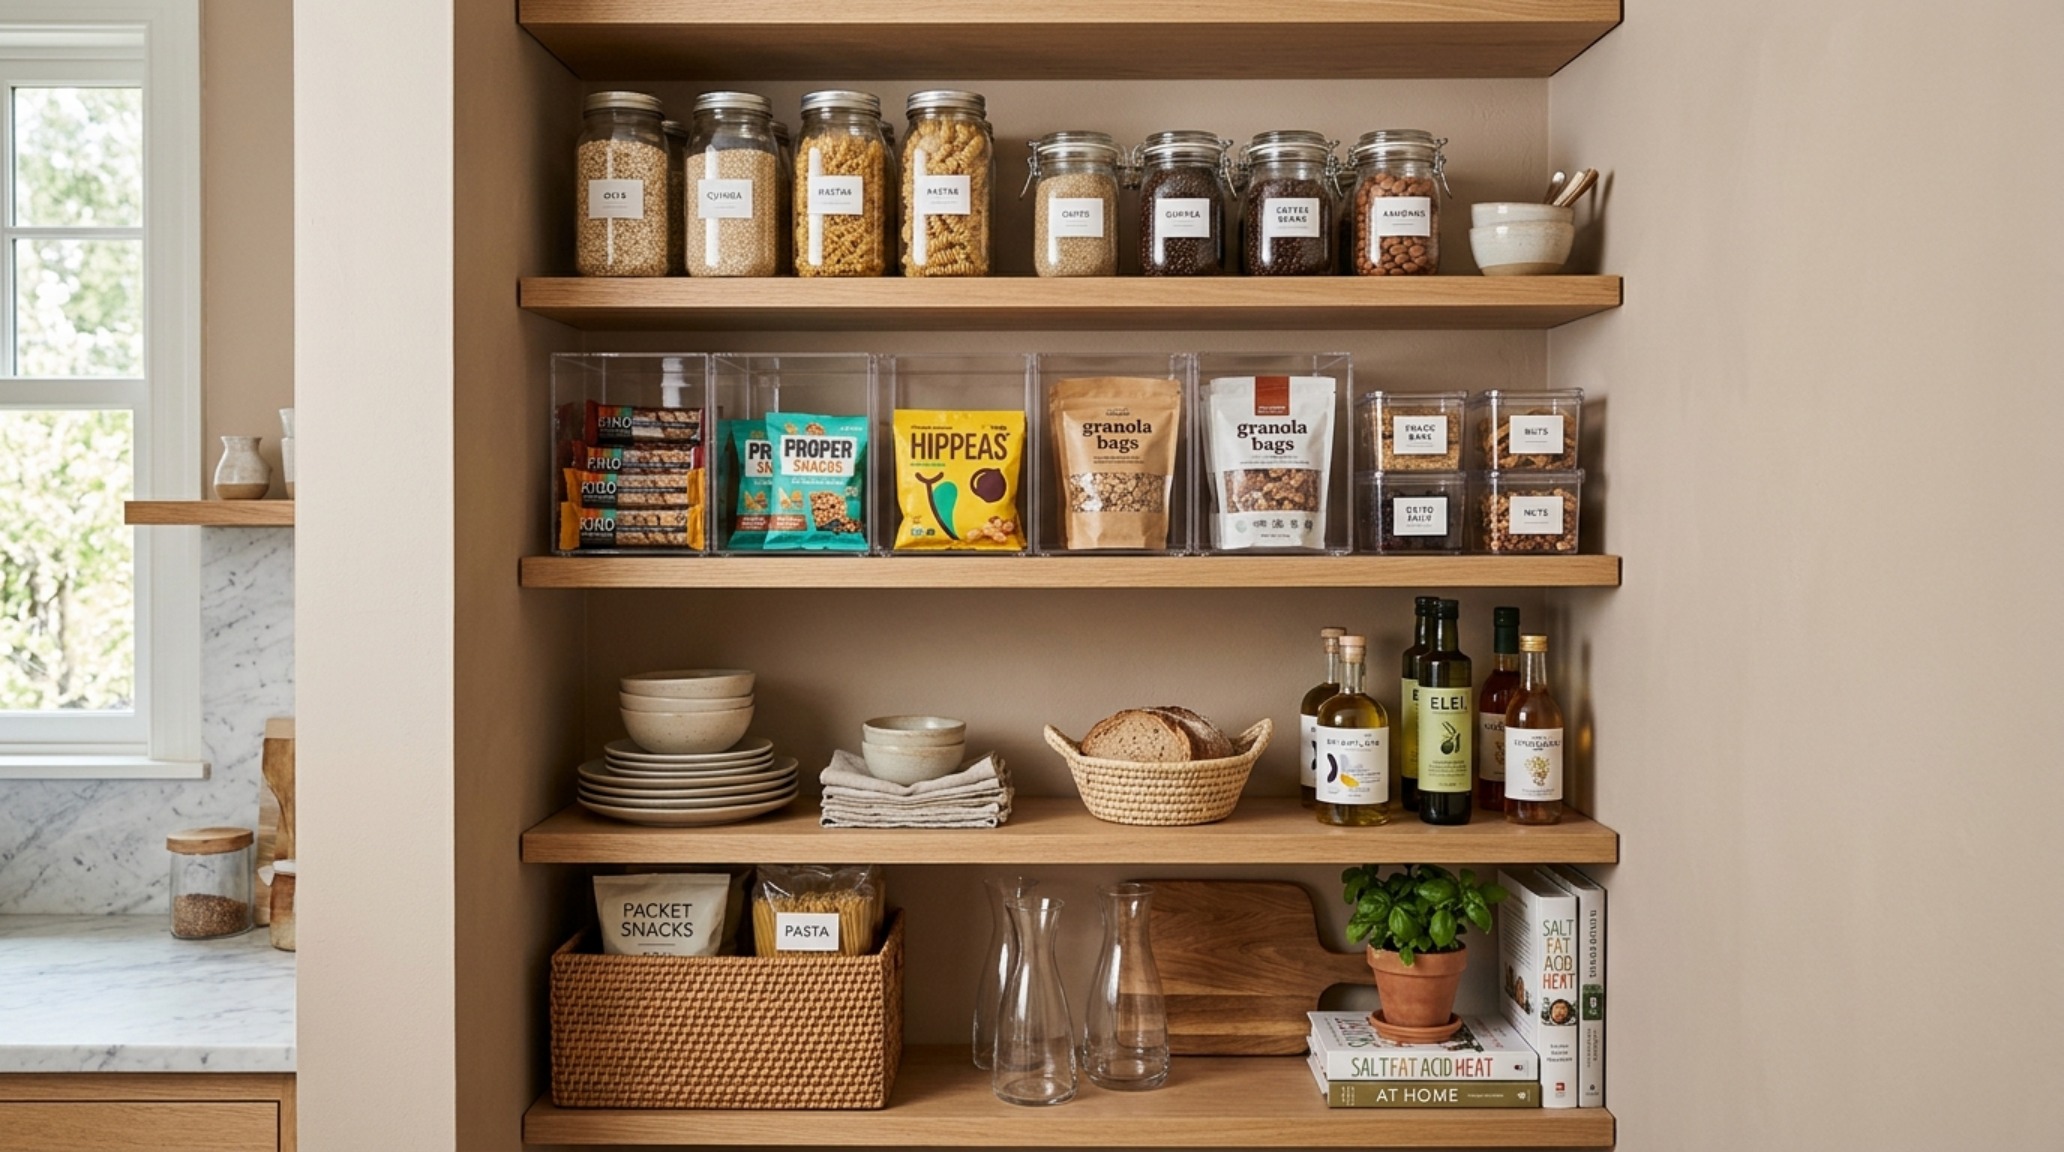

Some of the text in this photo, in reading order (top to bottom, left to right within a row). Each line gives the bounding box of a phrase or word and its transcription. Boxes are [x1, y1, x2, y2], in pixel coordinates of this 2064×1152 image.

[1082, 419, 1152, 437] granola
[1237, 419, 1308, 438] granola
[784, 438, 853, 459] PROPER
[911, 432, 1007, 460] HIPPEAS
[1096, 434, 1139, 453] bags
[1251, 436, 1295, 455] bags
[623, 903, 693, 919] PACKET
[621, 922, 694, 938] SNACKS
[785, 925, 830, 938] PASTA
[1543, 919, 1574, 937] SALT
[1546, 937, 1571, 954] FAT
[1351, 1057, 1494, 1078] SALT FAT ACID HEAT
[1376, 1088, 1459, 1103] AT HOME
